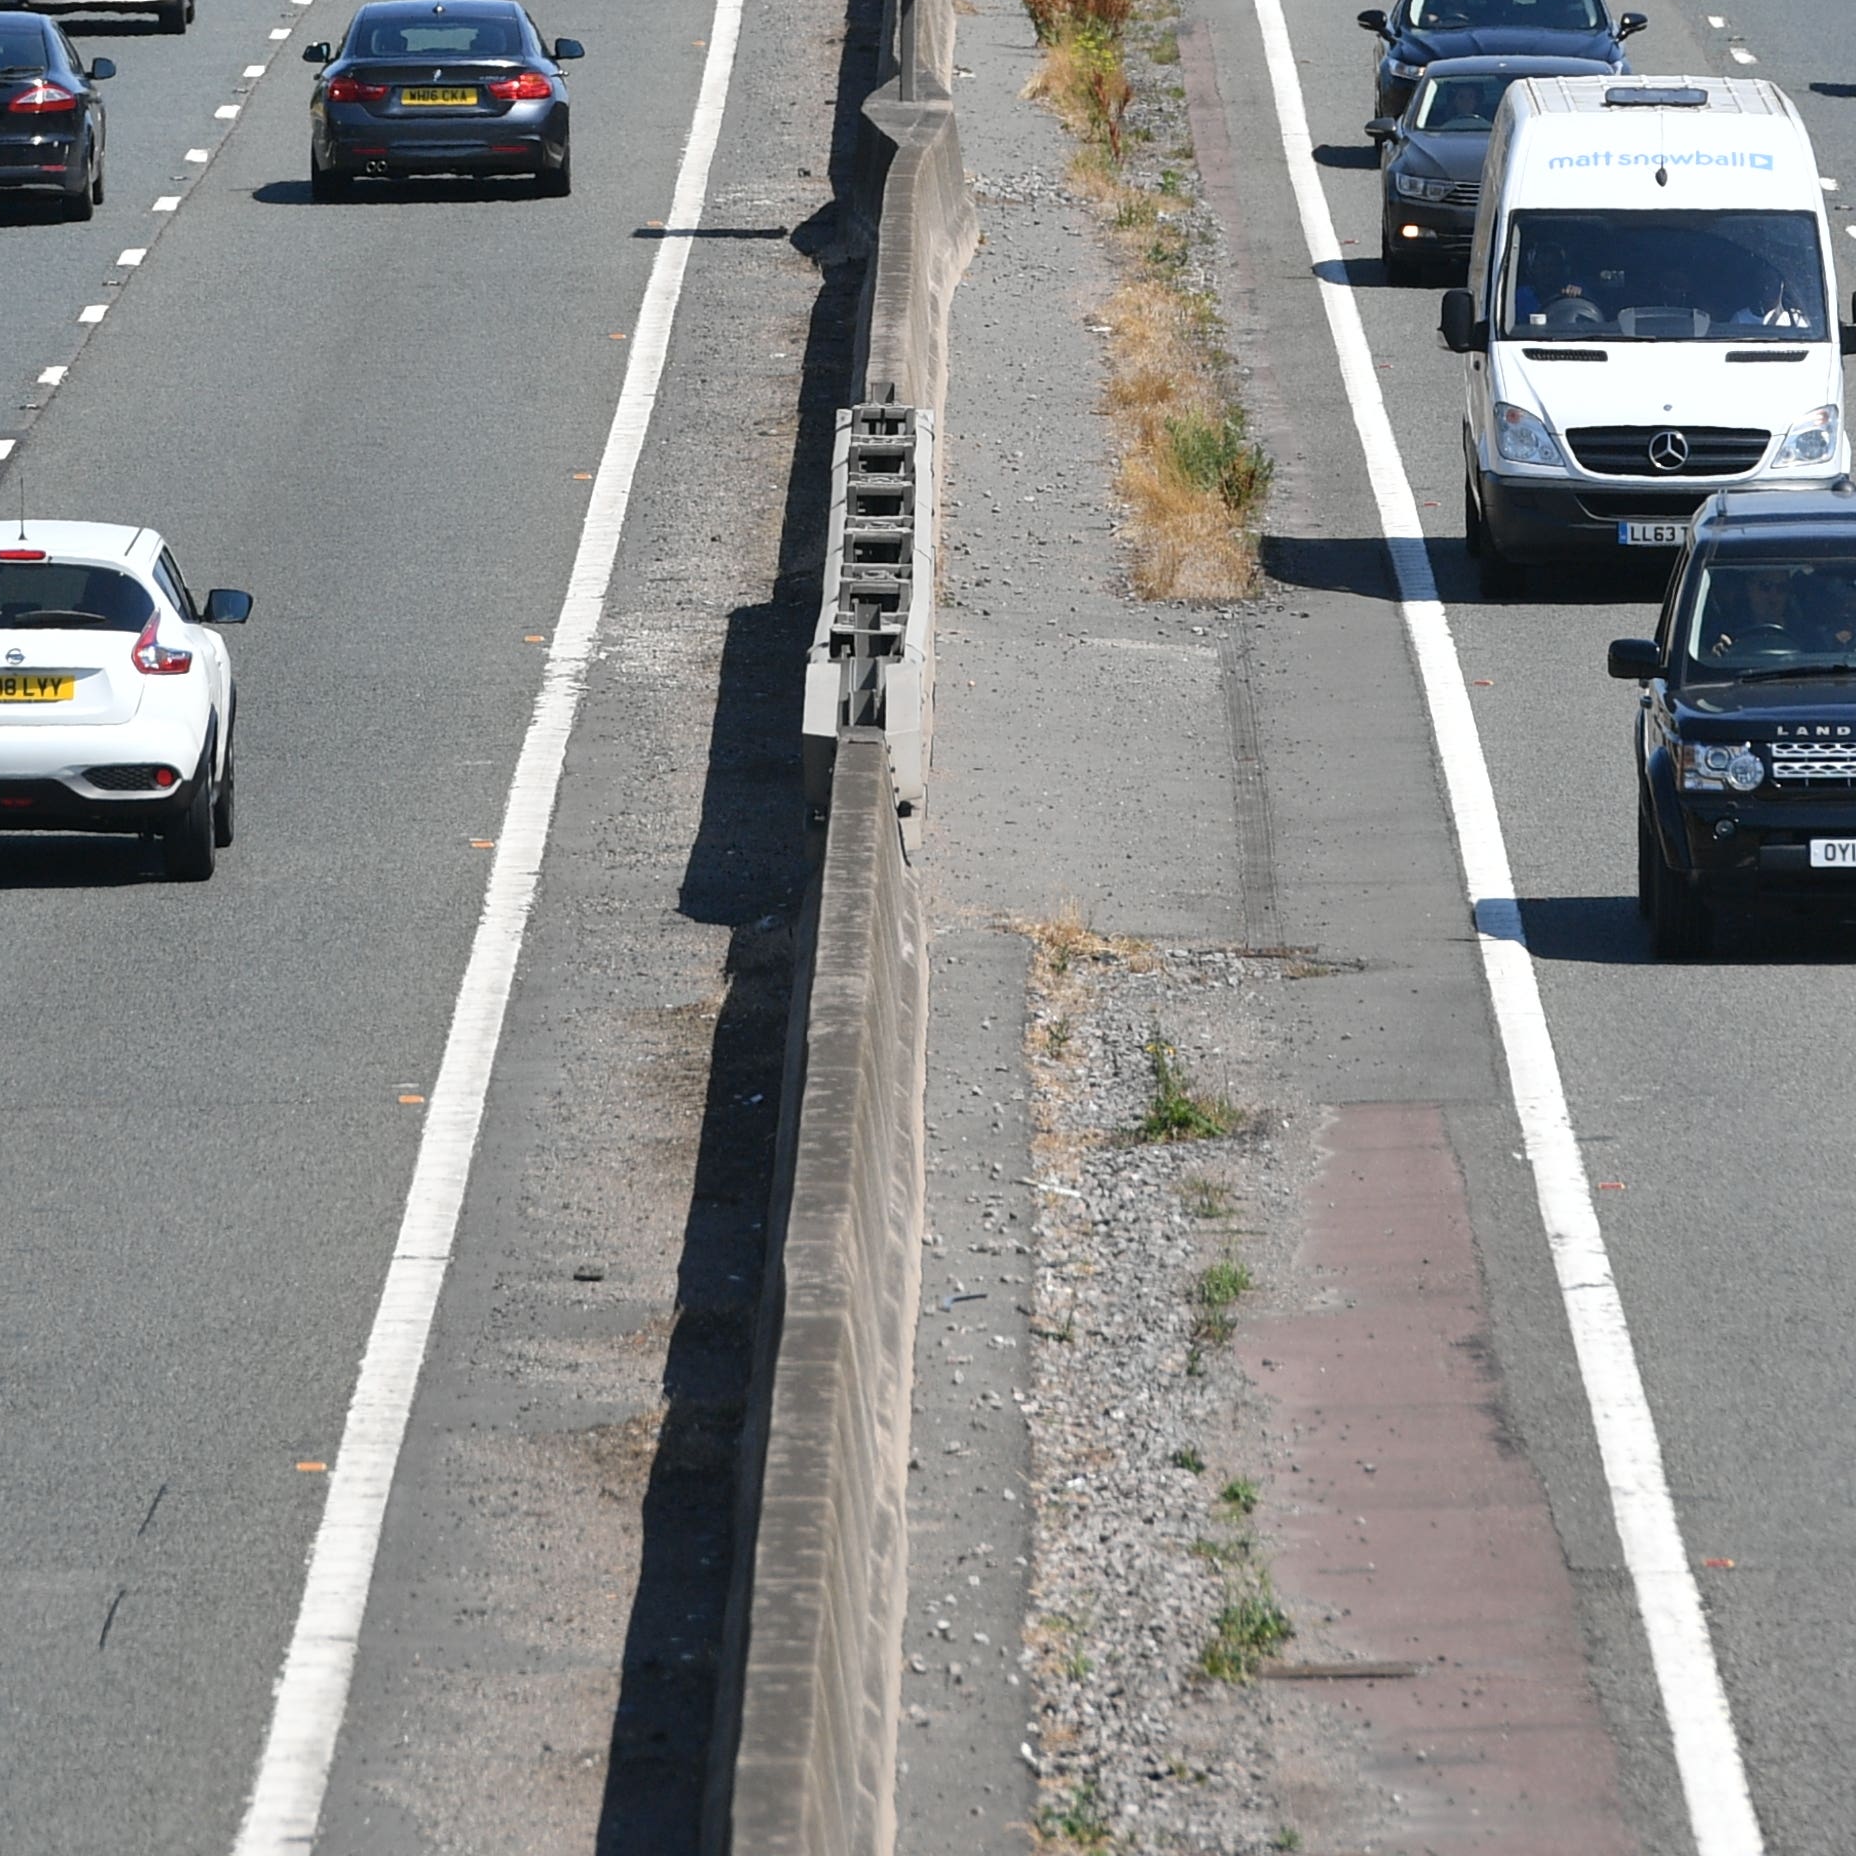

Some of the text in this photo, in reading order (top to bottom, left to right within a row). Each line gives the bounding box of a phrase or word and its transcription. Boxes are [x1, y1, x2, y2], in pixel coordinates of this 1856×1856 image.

[1548, 150, 1745, 170] matt snowball
[1630, 525, 1676, 542] LL63
[22, 676, 63, 696] LYY
[1776, 725, 1851, 736] LAND
